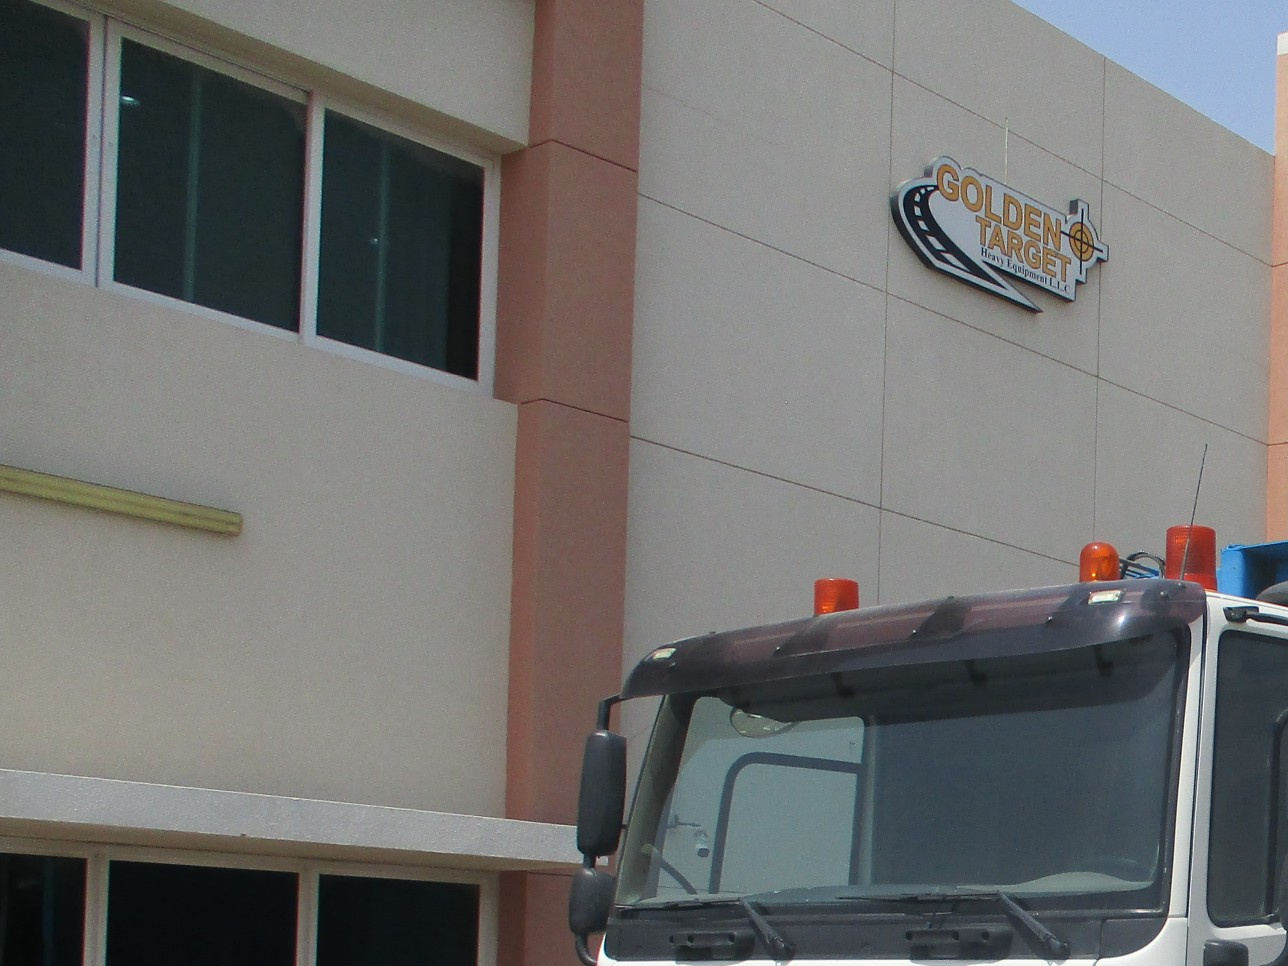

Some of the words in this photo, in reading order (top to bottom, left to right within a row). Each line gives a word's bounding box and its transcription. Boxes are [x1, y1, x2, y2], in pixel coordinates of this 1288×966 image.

[936, 164, 1062, 251] GOLDEN
[976, 215, 1072, 283] TARGET
[981, 247, 1004, 267] Heavy
[1007, 259, 1047, 284] Equipment
